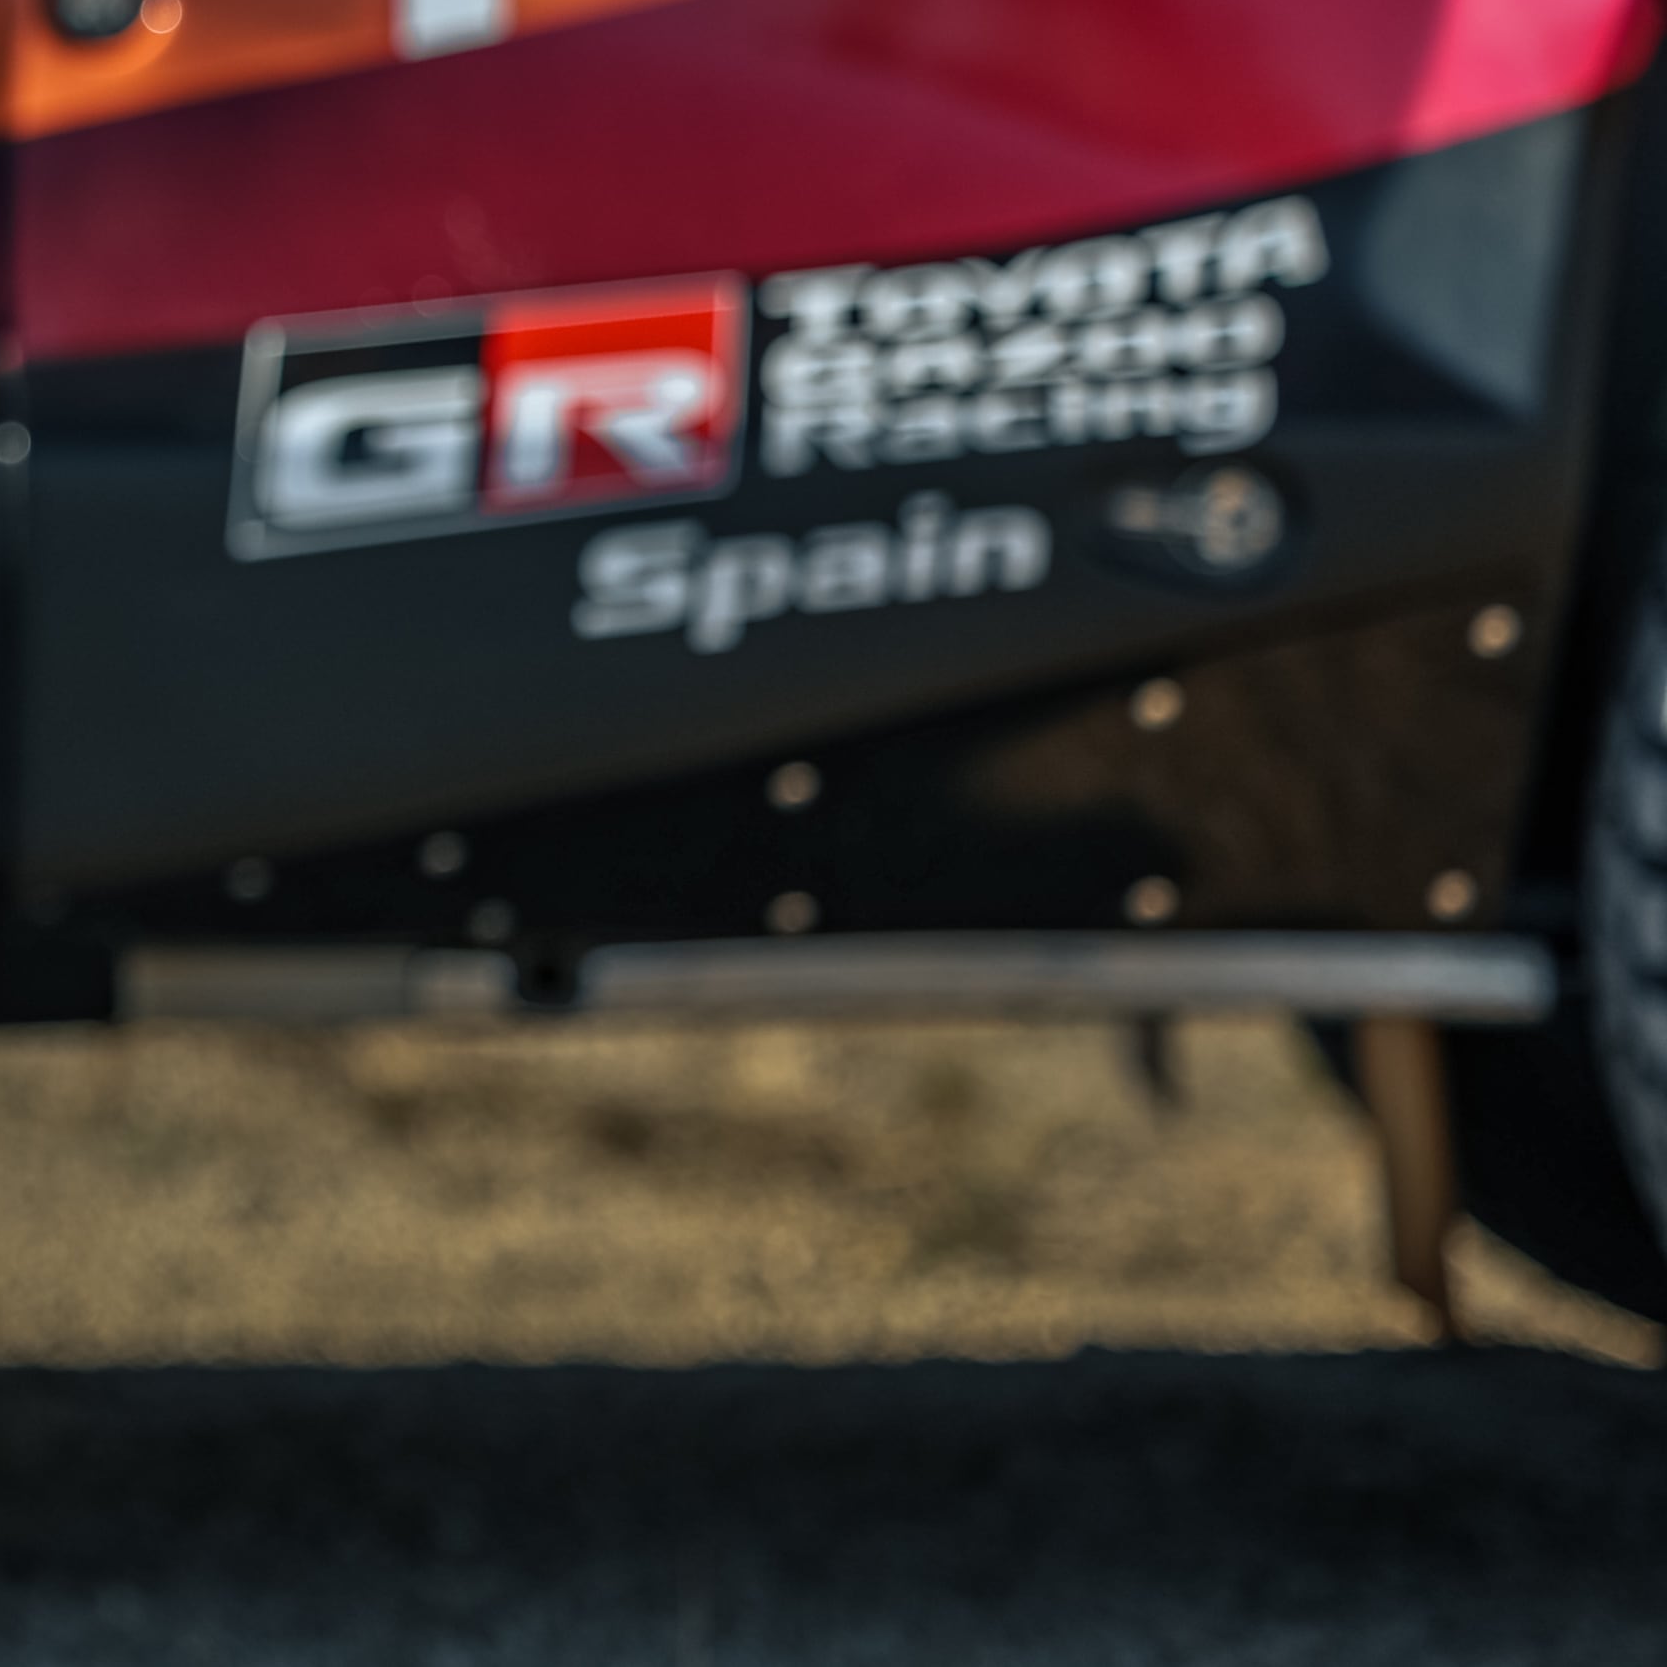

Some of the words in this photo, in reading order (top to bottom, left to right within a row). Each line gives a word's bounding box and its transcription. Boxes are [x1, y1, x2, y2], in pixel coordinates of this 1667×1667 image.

[759, 196, 1329, 342] TOYOTA
[259, 352, 735, 530] GR
[572, 490, 1053, 654] Spain
